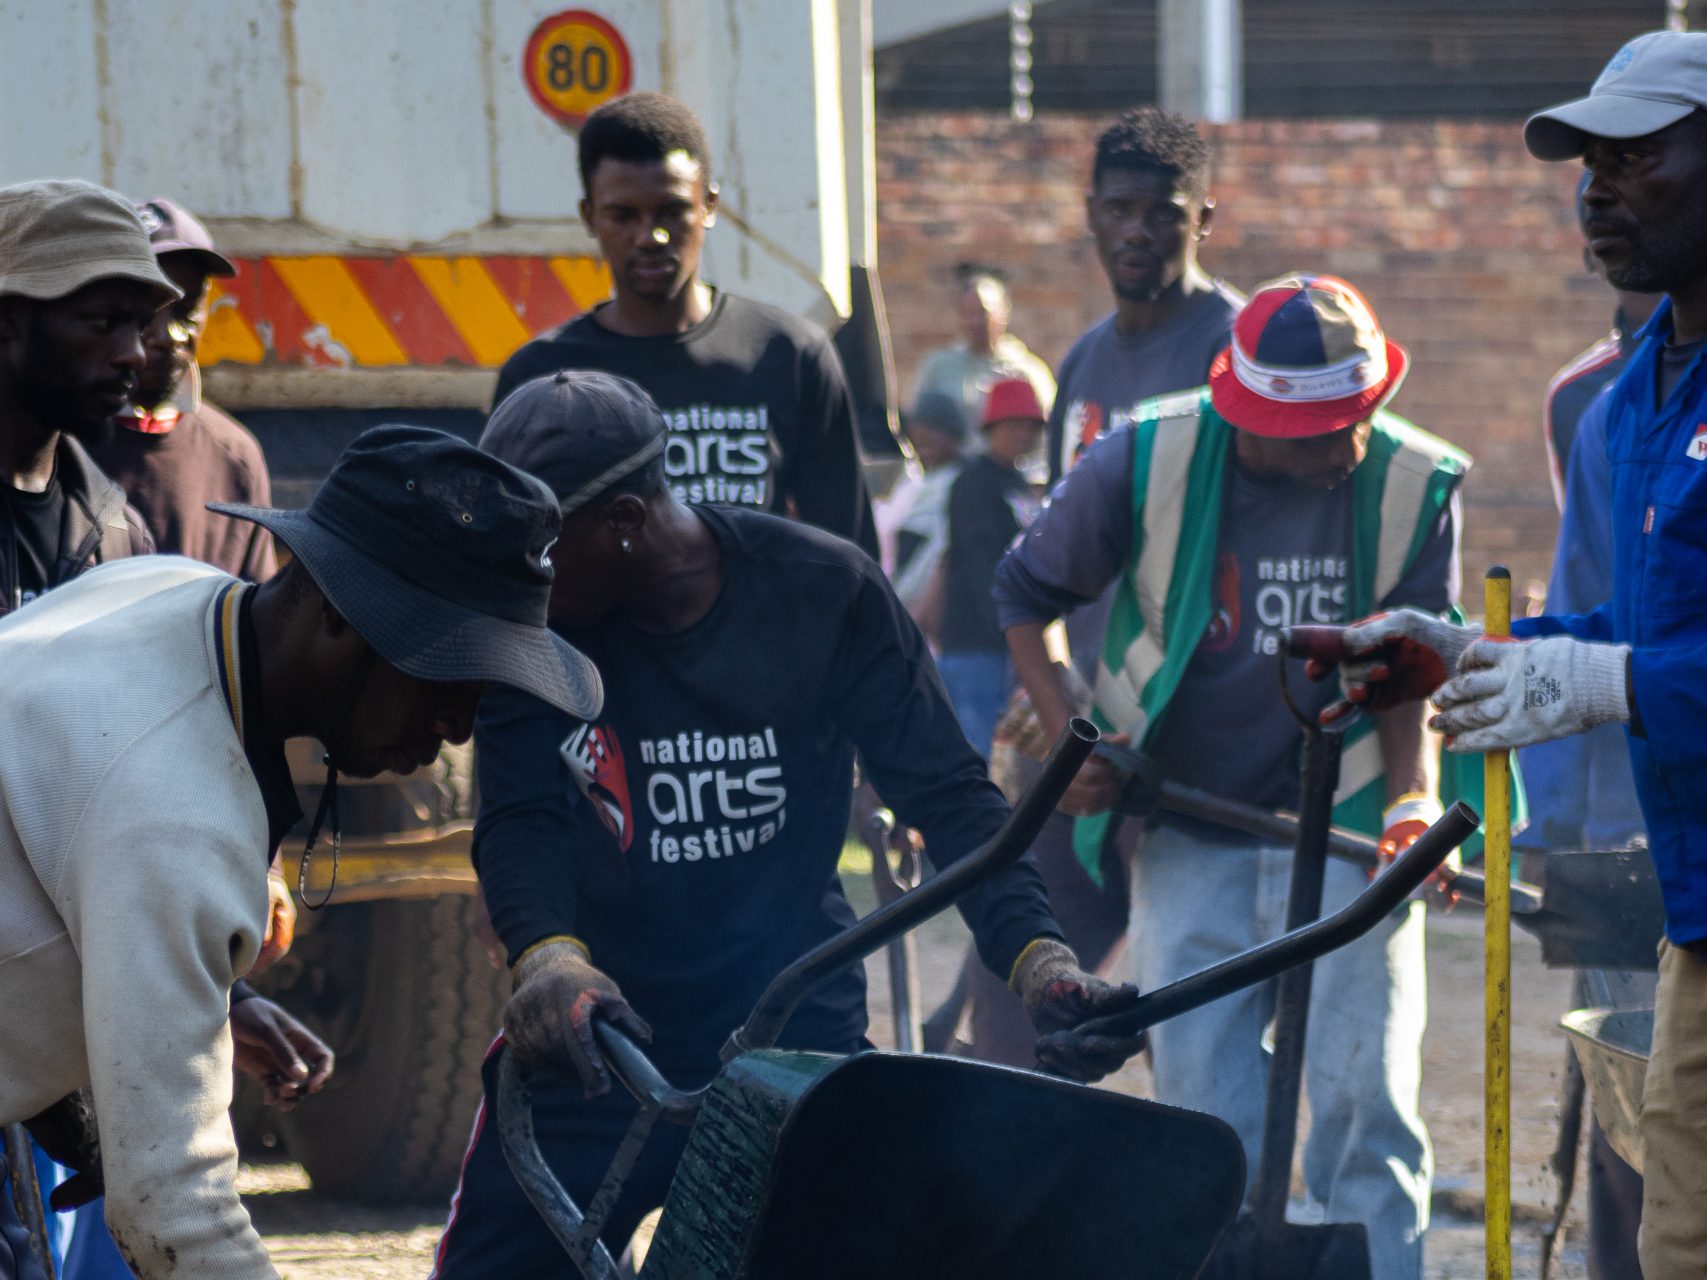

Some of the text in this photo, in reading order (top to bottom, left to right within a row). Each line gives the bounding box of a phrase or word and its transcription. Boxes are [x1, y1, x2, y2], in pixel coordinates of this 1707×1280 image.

[548, 43, 609, 93] 80
[664, 435, 769, 477] arts
[663, 478, 766, 504] estival
[639, 727, 779, 764] national
[647, 766, 787, 826] arts
[650, 807, 787, 864] festival
